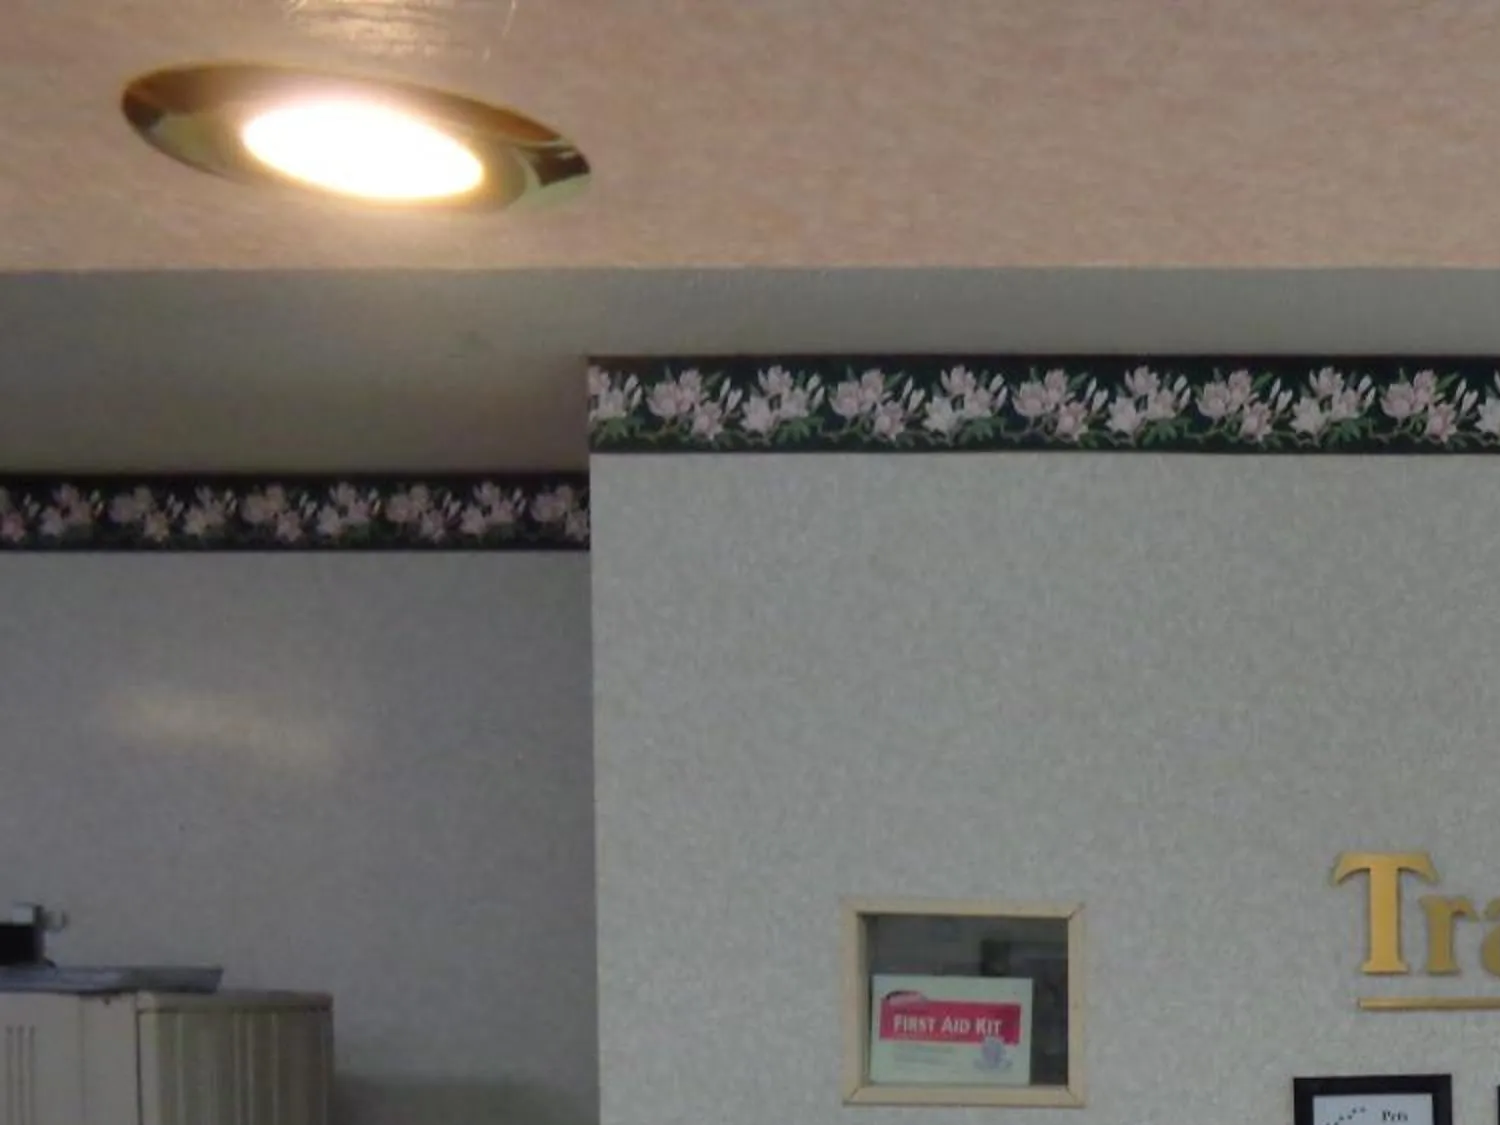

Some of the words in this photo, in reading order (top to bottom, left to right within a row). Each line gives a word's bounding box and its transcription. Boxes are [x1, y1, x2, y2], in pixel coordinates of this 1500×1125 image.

[893, 1014, 936, 1033] FIRST
[941, 1016, 971, 1033] AID
[976, 1016, 1004, 1034] KIT
[1382, 1109, 1409, 1121] Pets
